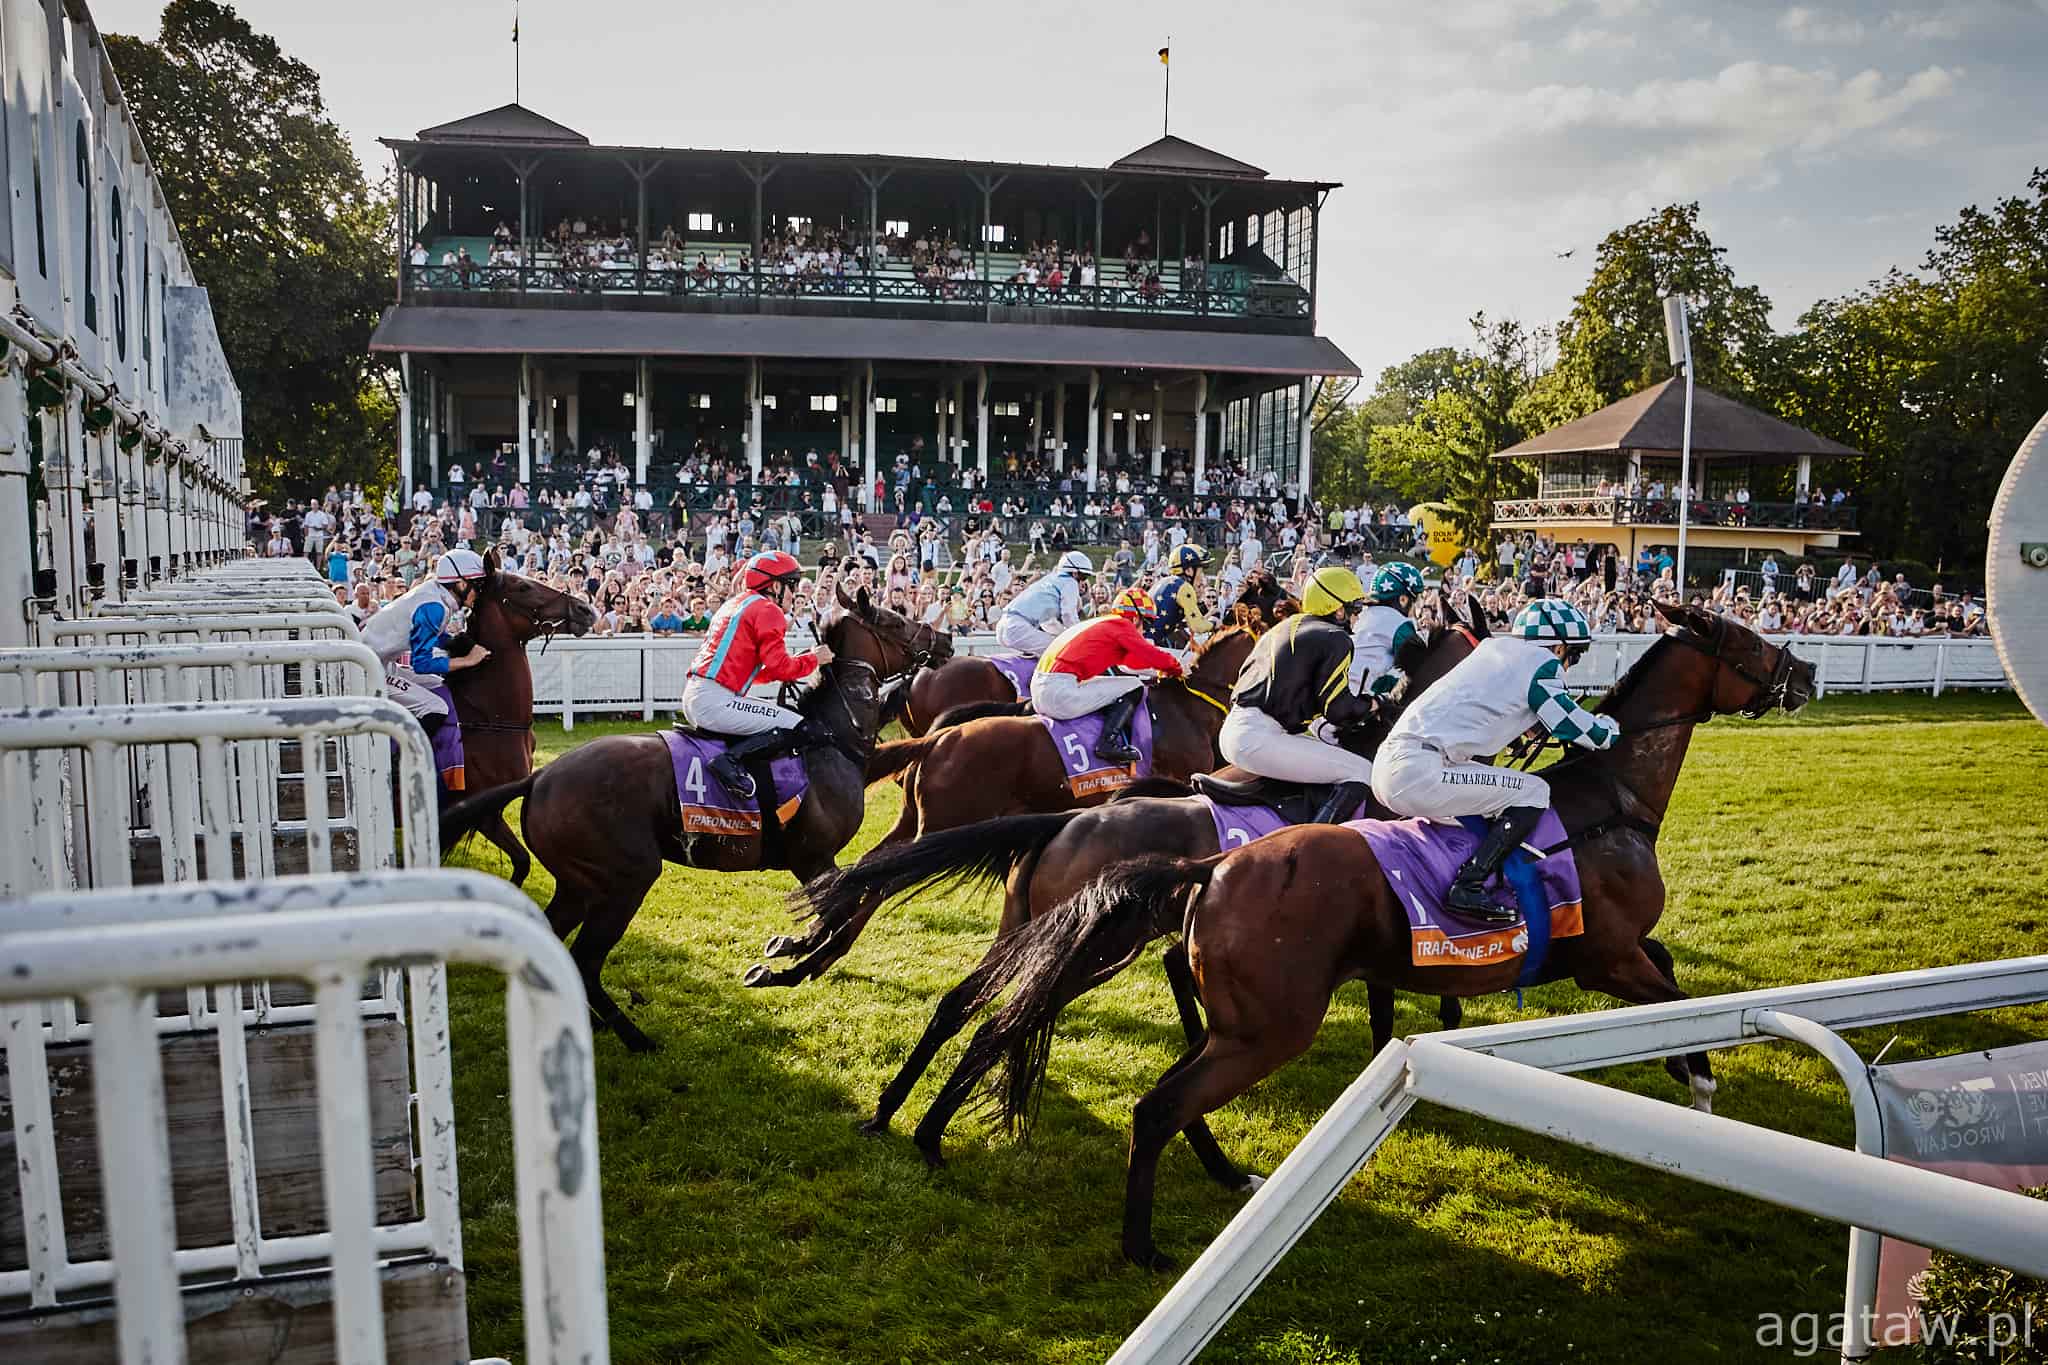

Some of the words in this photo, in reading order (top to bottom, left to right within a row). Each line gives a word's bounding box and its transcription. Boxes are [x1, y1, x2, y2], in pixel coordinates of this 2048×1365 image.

[76, 119, 97, 336] 2
[111, 184, 125, 363] 3
[685, 756, 707, 804] 4
[1063, 733, 1090, 772] 5
